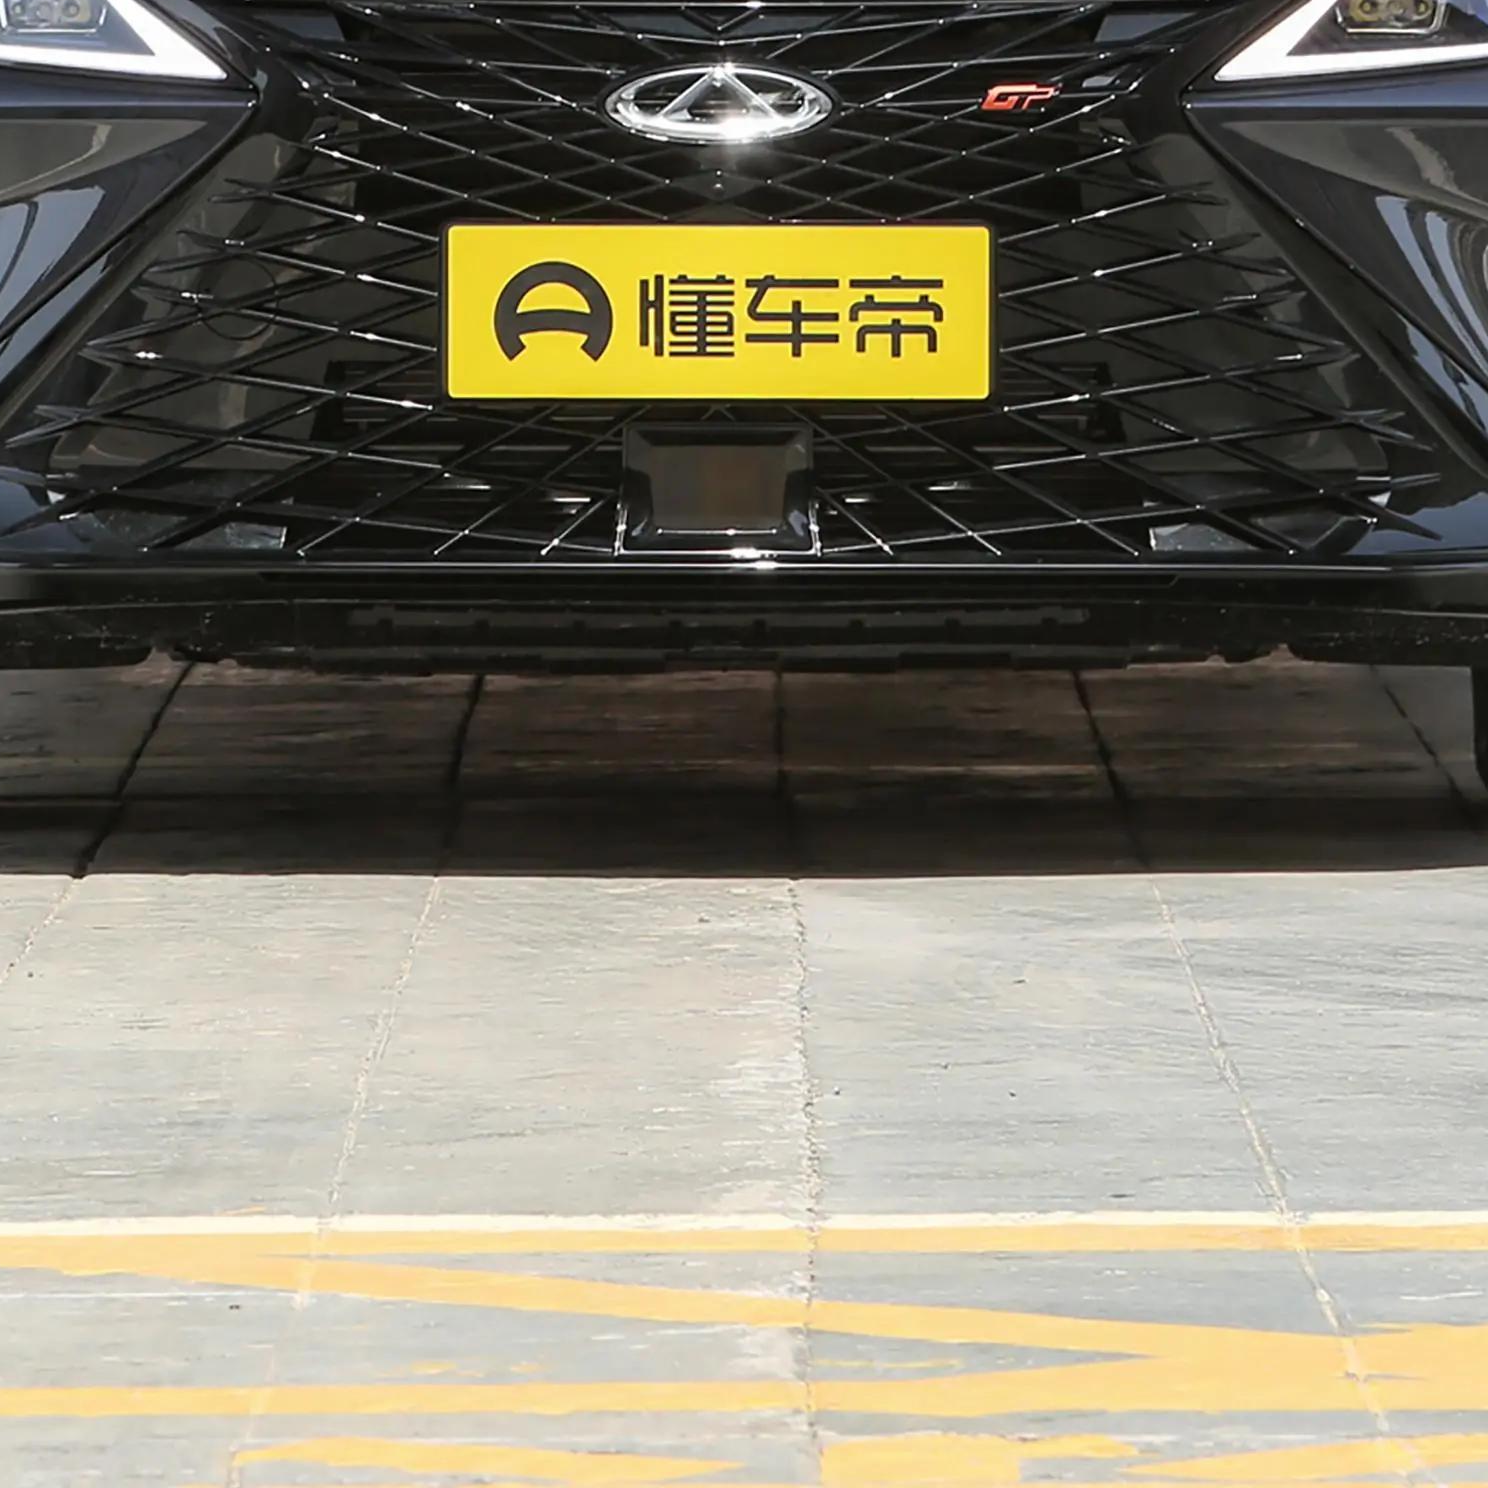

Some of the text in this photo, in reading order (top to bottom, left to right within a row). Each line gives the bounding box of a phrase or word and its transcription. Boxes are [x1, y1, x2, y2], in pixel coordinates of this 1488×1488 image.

[981, 84, 1061, 111] GT
[639, 273, 944, 359] 懂车帝
